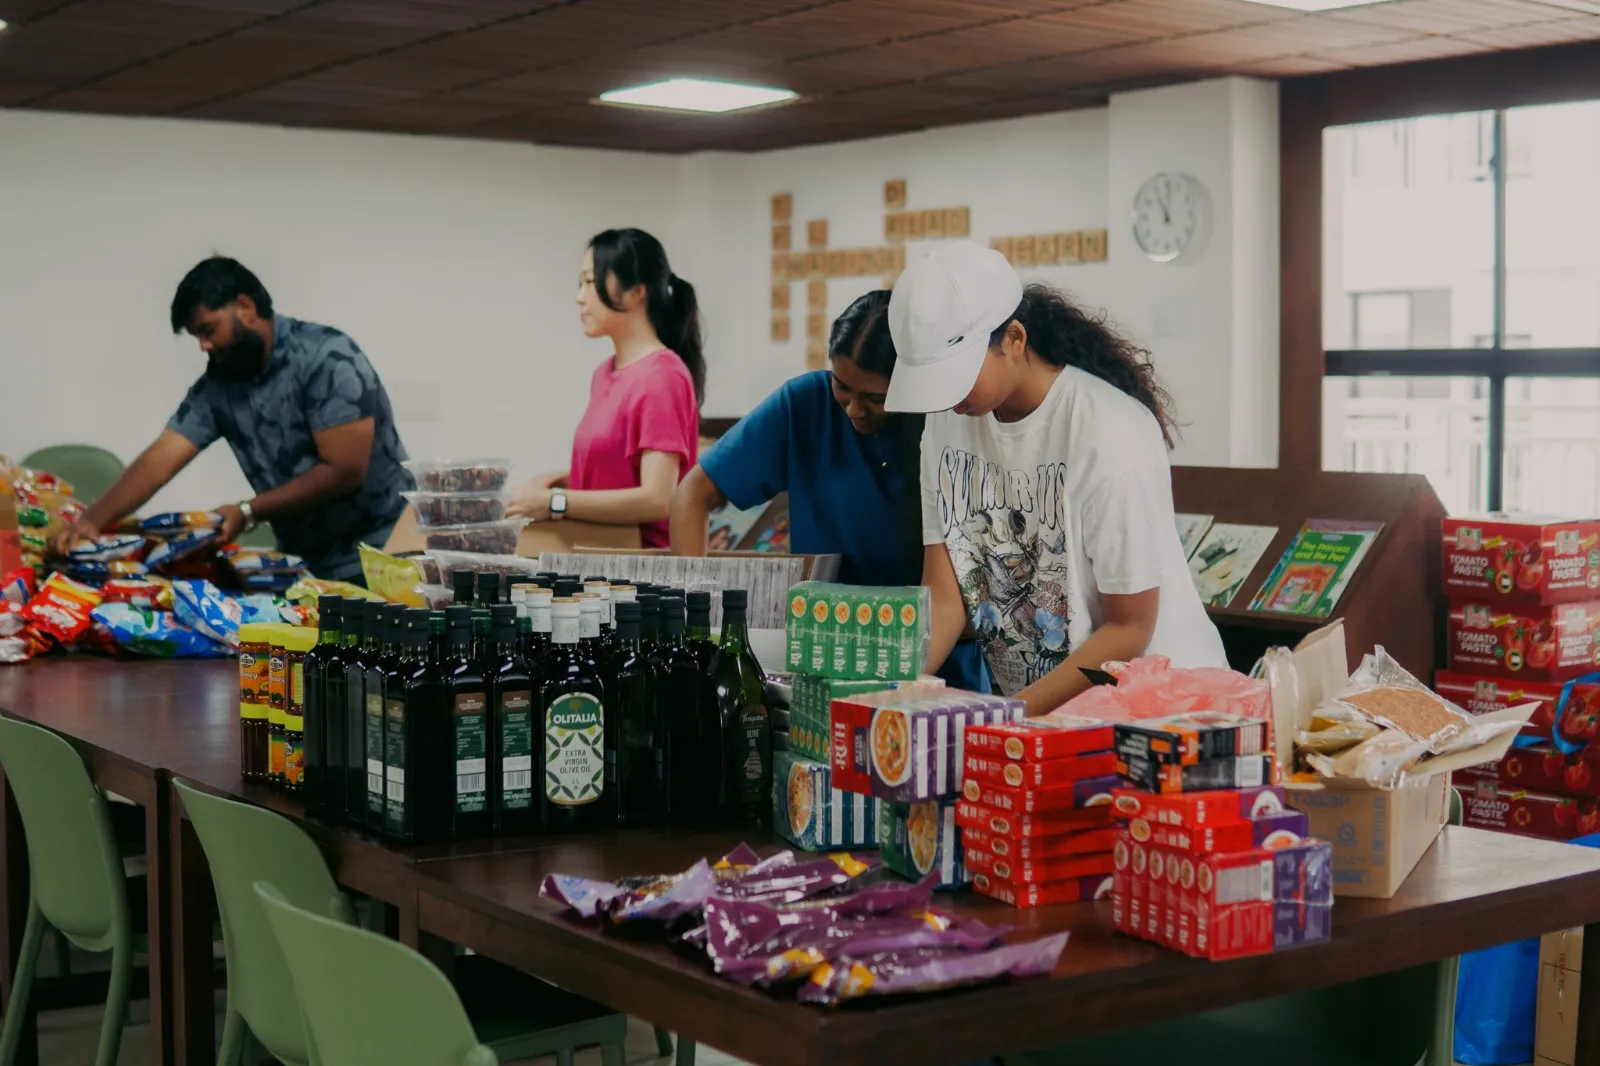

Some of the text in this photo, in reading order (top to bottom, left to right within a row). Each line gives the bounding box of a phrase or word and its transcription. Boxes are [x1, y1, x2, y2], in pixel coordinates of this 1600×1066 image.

[1449, 554, 1488, 568] TOMATO
[1548, 557, 1586, 570] TOMATO
[1453, 566, 1484, 577] PASTE
[1456, 631, 1498, 644] TOMATO
[1460, 642, 1492, 654] PASTE
[553, 713, 597, 725] OLITALIA
[746, 729, 760, 738] OLIVE
[834, 722, 848, 770] RUH
[1468, 798, 1510, 812] TOMATO
[1471, 809, 1504, 820] PASTE
